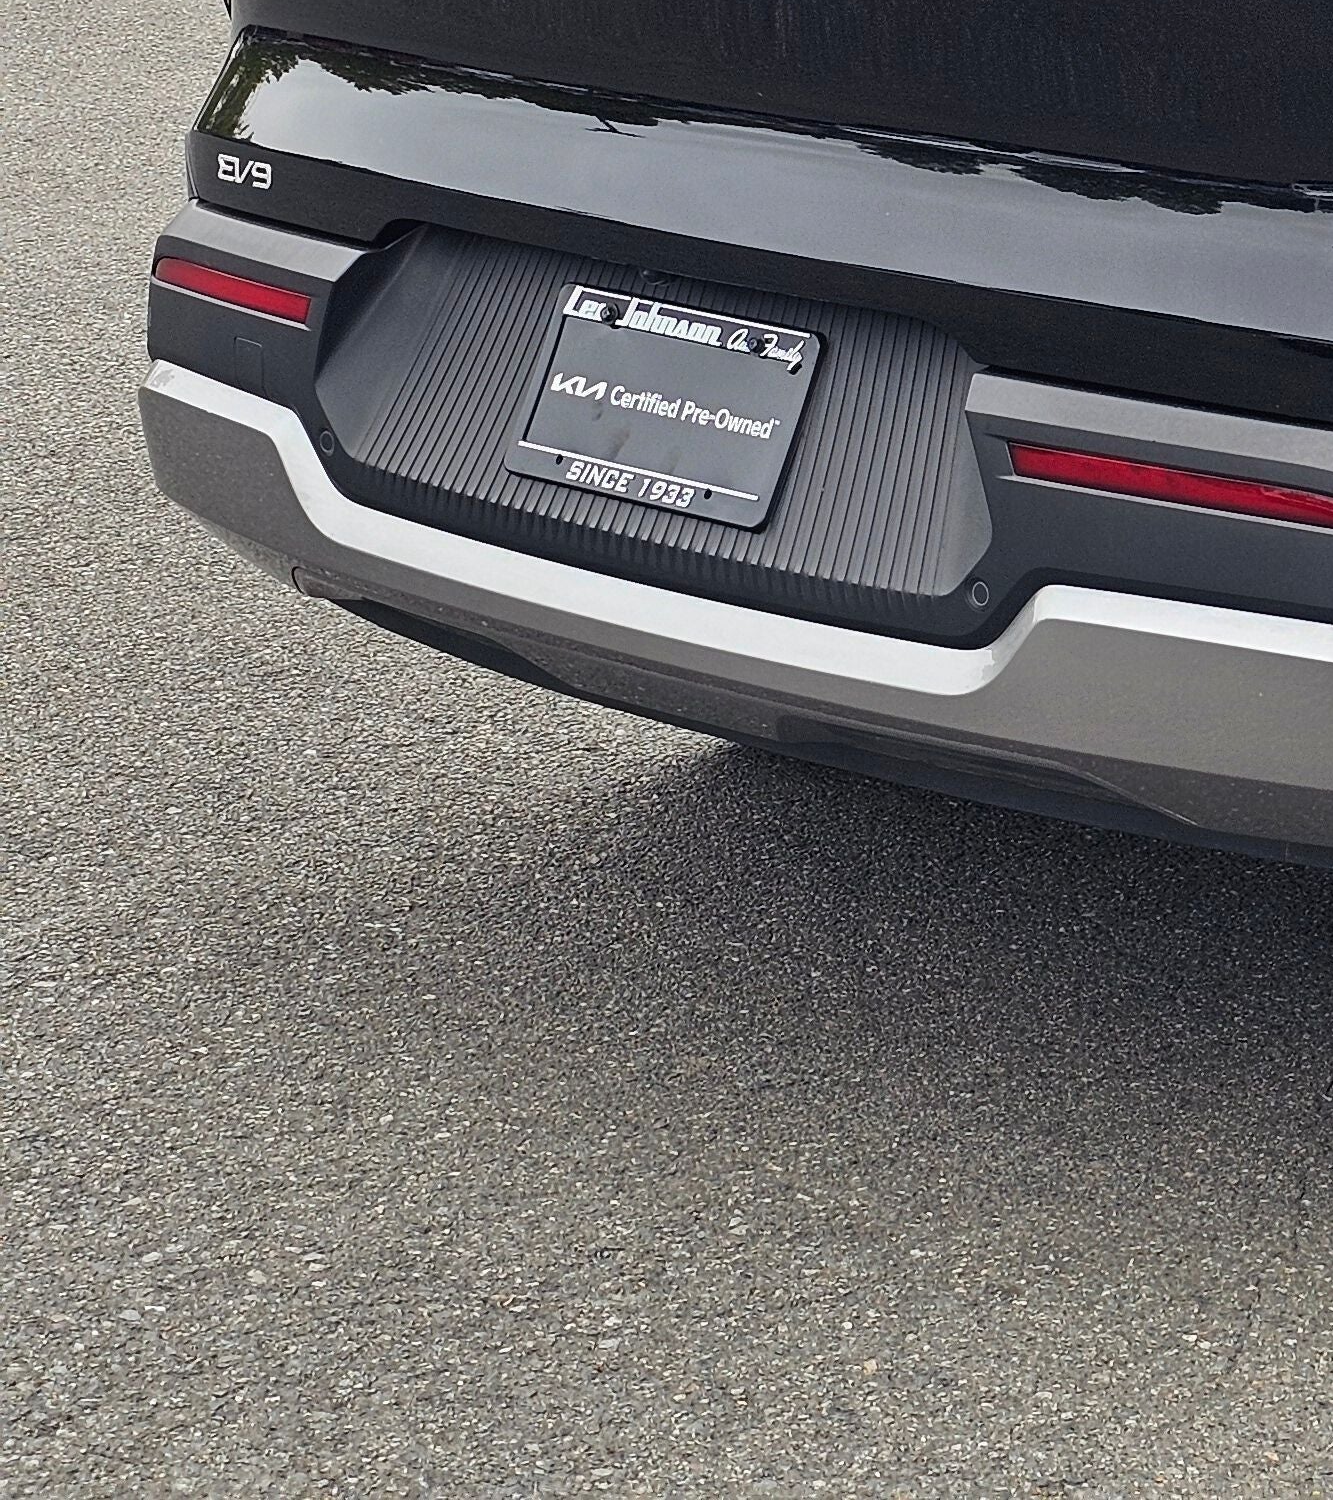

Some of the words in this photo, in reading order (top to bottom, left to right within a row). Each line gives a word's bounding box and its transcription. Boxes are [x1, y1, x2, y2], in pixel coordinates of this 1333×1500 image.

[217, 153, 273, 190] EV9
[550, 372, 608, 401] KIA
[609, 384, 683, 420] Certified
[564, 460, 635, 494] SINCE
[636, 477, 696, 508] 1933
